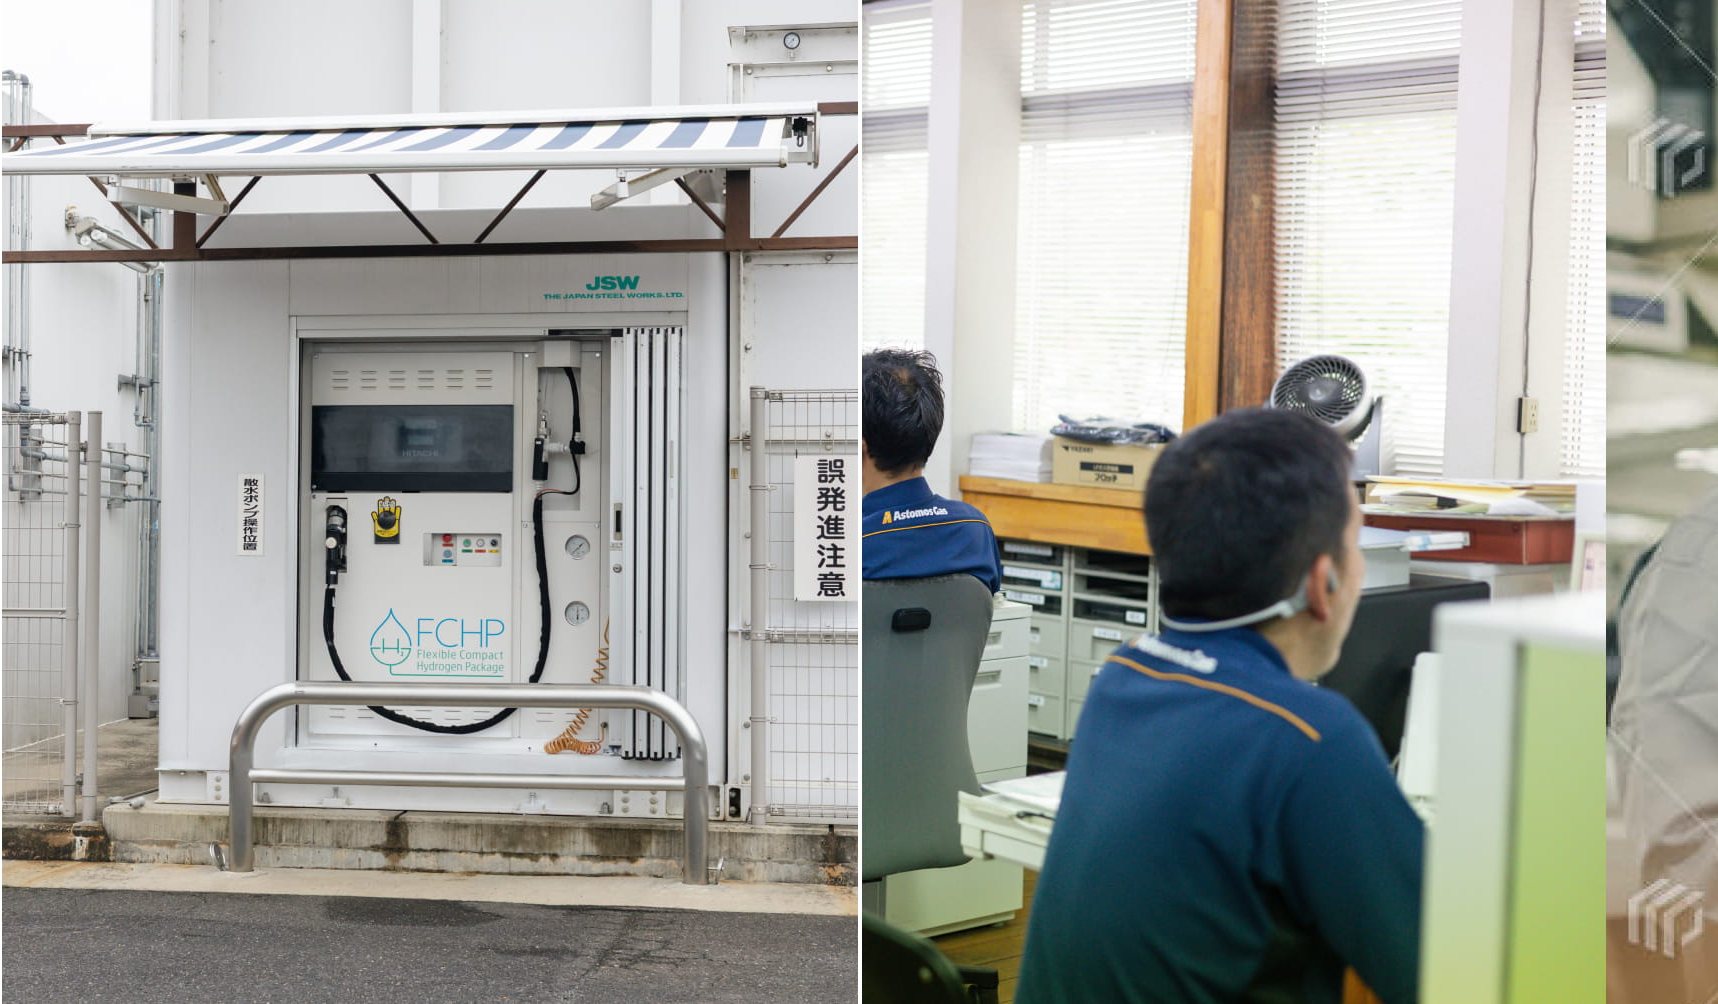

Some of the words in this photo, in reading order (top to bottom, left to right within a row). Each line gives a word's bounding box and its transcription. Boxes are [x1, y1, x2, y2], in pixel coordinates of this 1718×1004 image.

[586, 275, 640, 291] JSW
[402, 449, 439, 457] HITACHI
[816, 458, 846, 597] 誤発進注意
[417, 618, 505, 648] FCHP
[417, 649, 456, 660] Flexible
[459, 649, 504, 661] Compact
[417, 661, 463, 673] Hydrogen
[465, 662, 505, 674] Package
